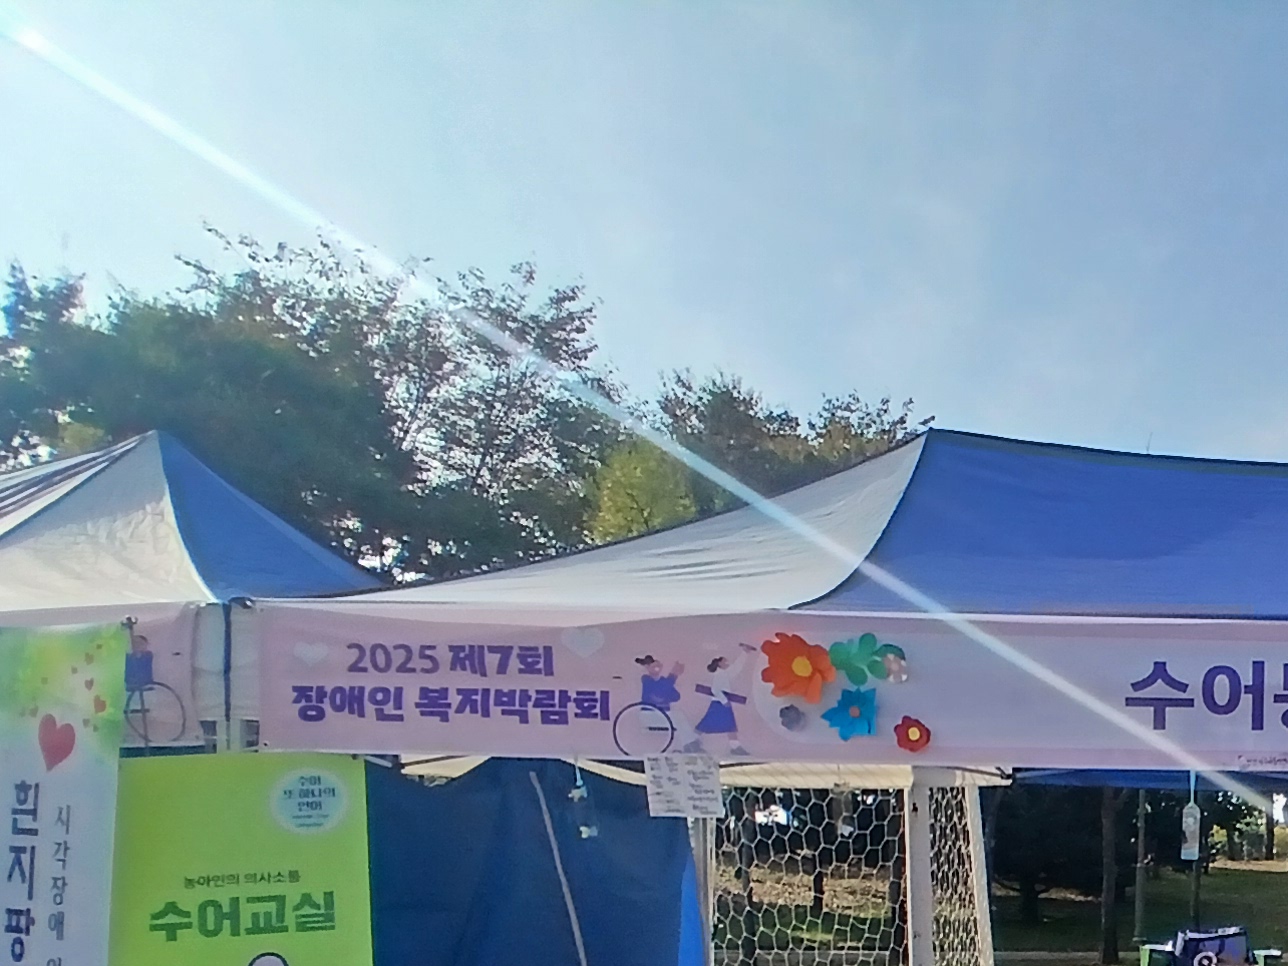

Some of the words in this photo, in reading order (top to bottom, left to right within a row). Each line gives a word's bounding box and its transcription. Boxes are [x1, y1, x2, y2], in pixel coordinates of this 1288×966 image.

[347, 643, 440, 673] 2025
[448, 644, 554, 677] 제7회
[291, 685, 404, 722] 장애인
[414, 686, 610, 725] 복지박람회
[48, 804, 71, 941] 시각장애
[149, 890, 336, 942] 수어교실
